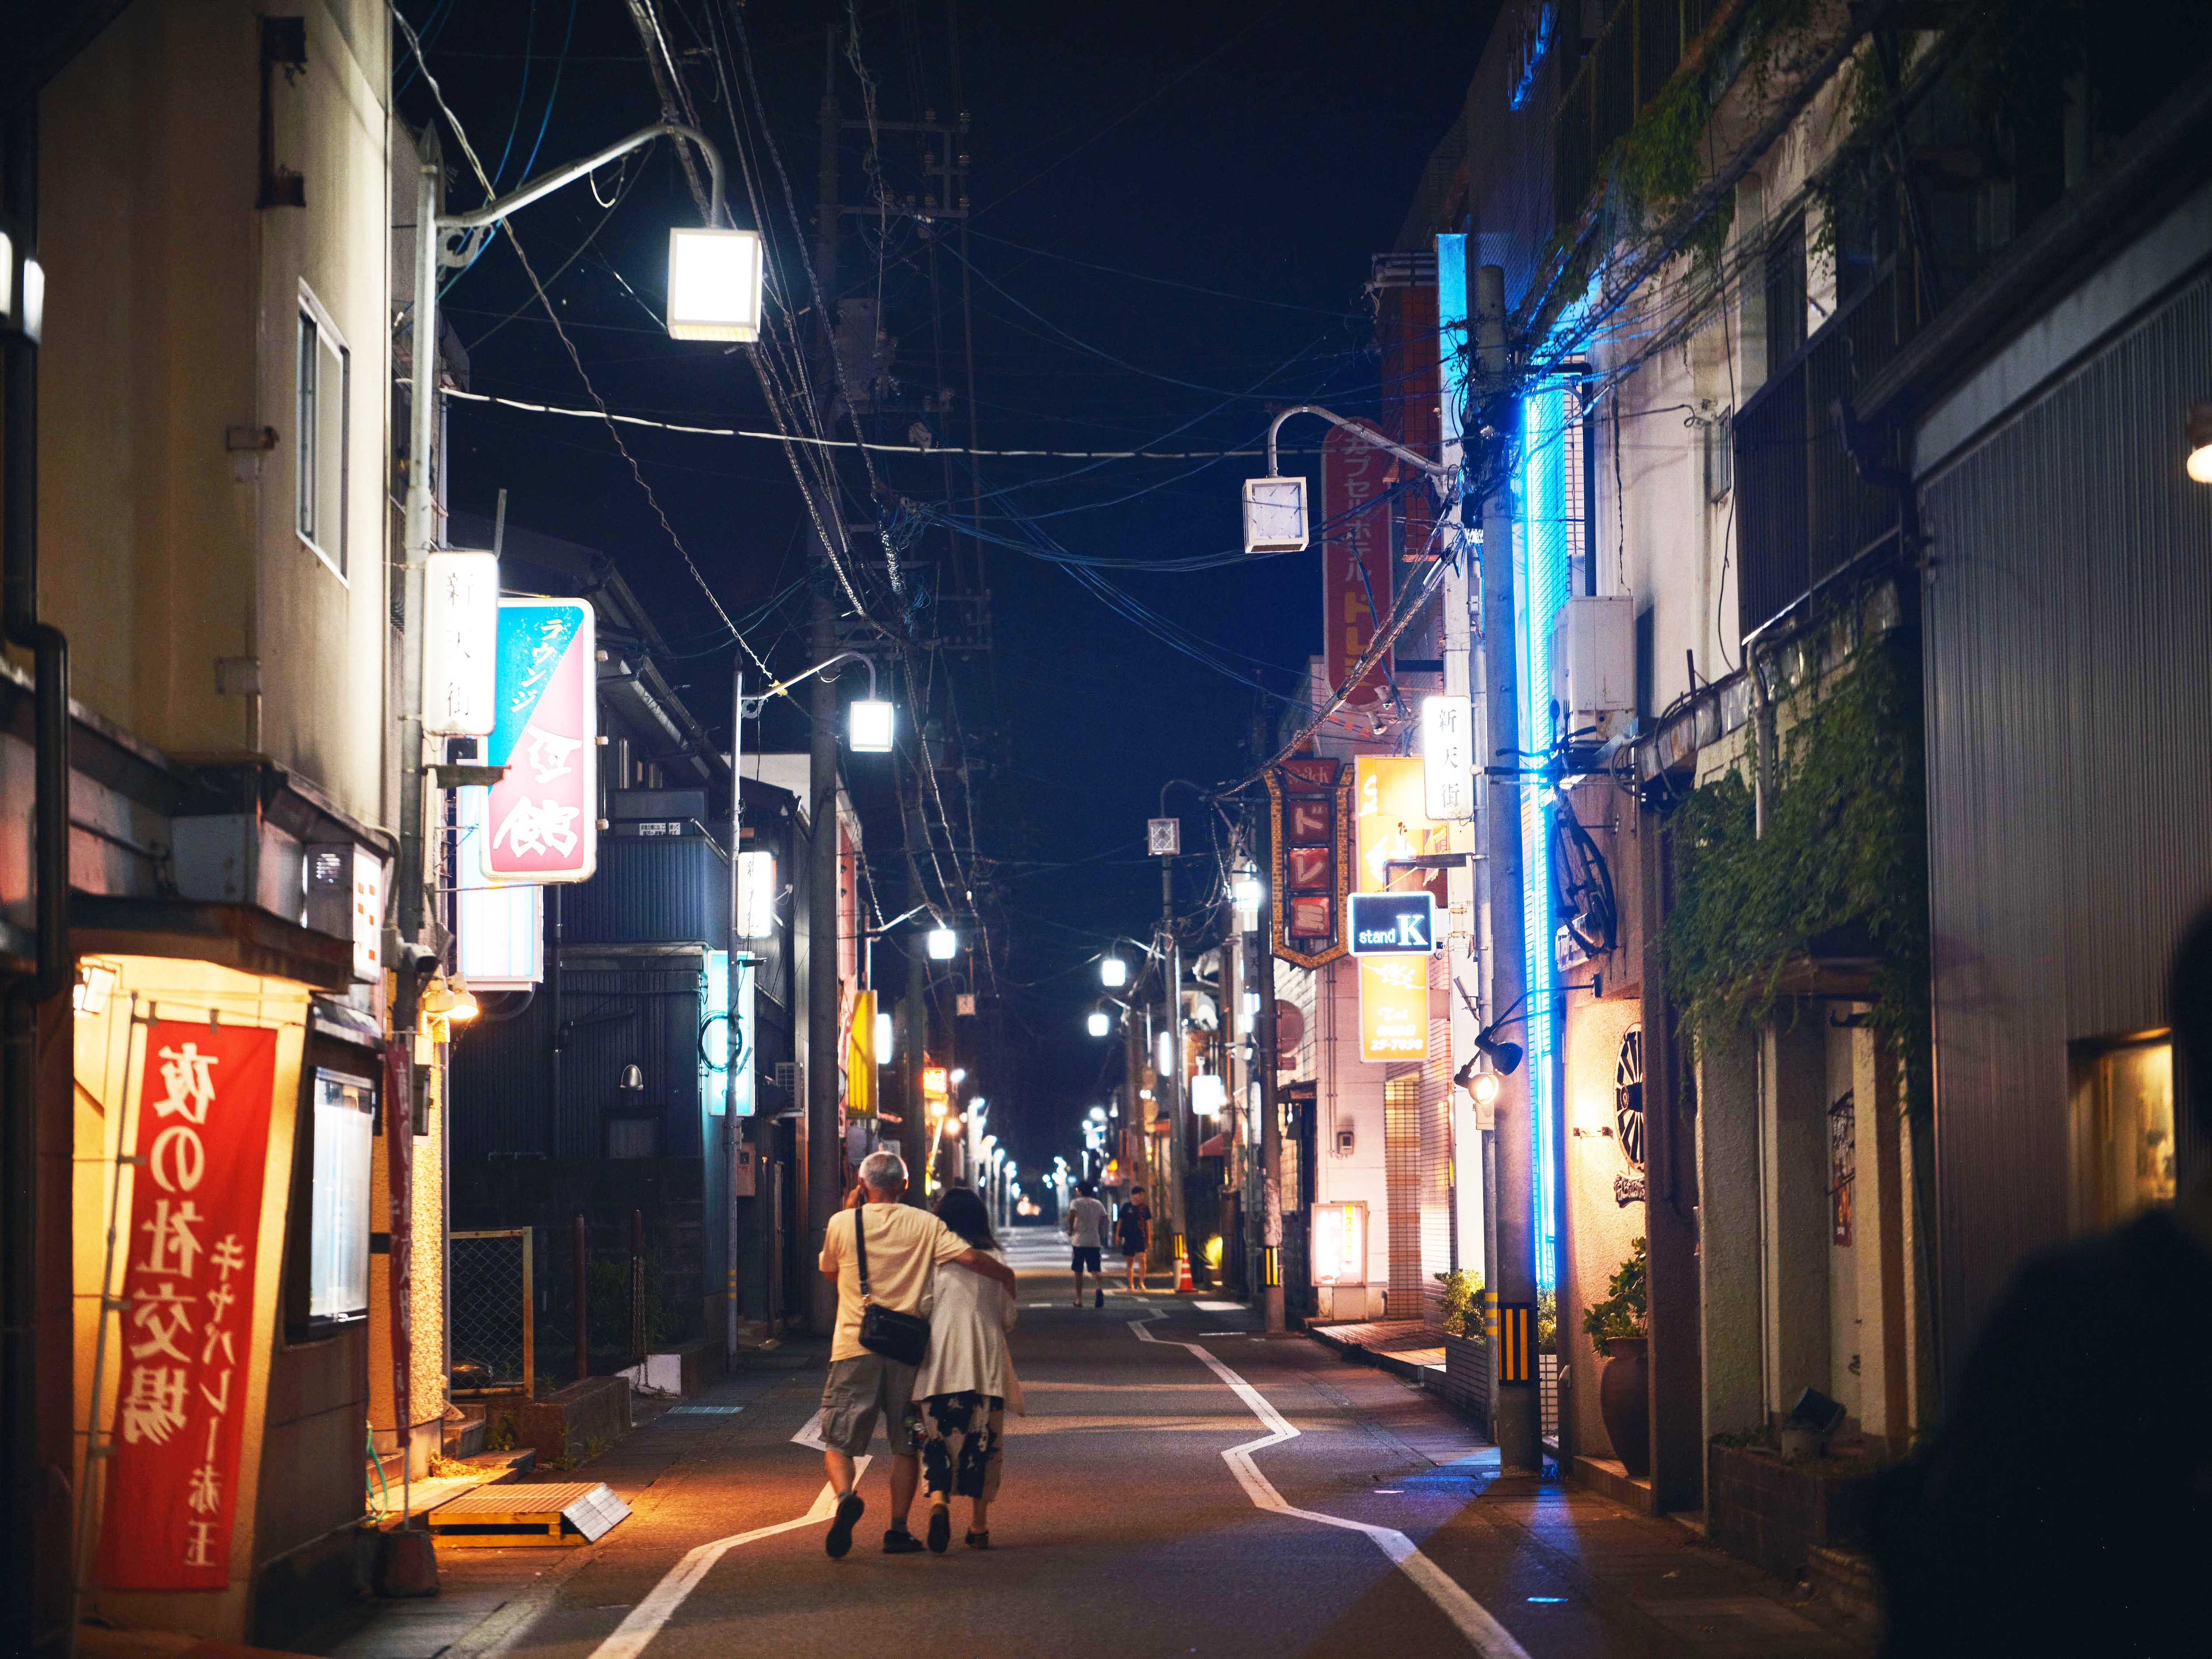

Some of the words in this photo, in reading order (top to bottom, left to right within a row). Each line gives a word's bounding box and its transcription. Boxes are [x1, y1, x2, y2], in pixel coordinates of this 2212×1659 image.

[445, 573, 473, 716] 新天街
[511, 619, 564, 712] ラウンジ
[1439, 709, 1459, 807] 新天街
[1294, 805, 1326, 931] ドレミ
[1359, 929, 1395, 945] stand
[1397, 914, 1428, 946] K
[1378, 1007, 1409, 1022] Tel
